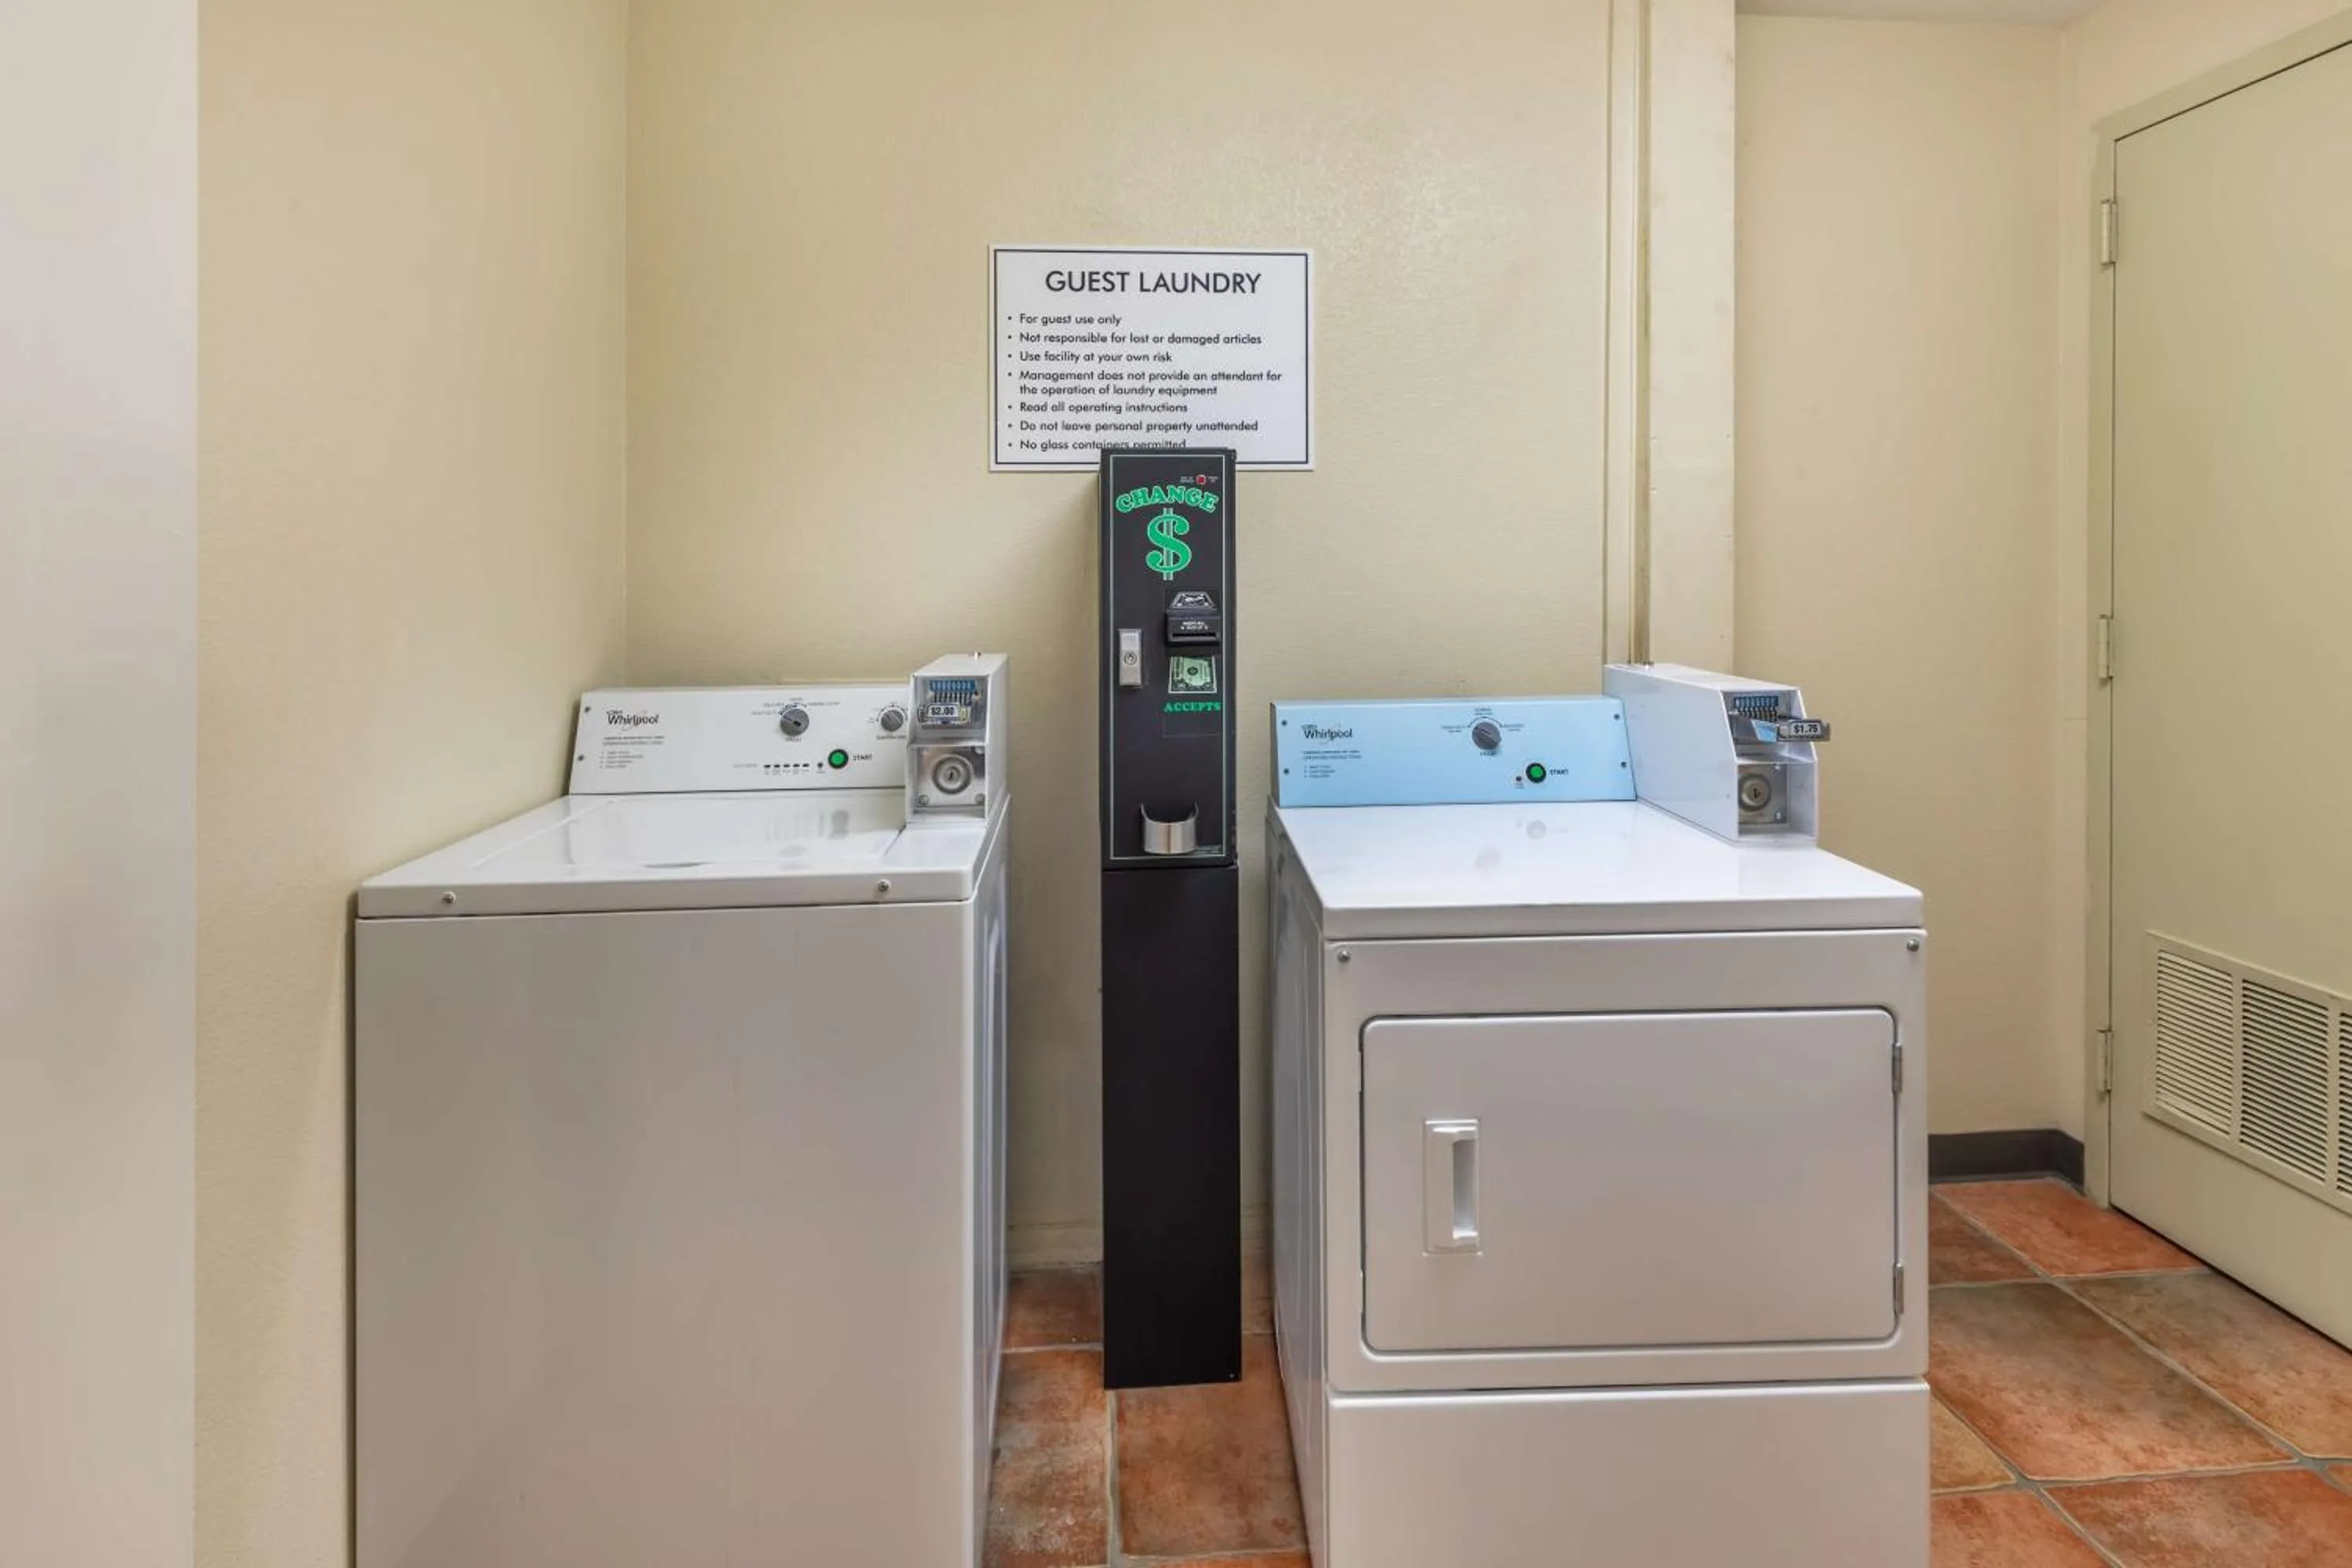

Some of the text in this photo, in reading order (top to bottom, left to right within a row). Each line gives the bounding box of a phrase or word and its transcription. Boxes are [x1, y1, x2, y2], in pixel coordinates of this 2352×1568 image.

[1046, 270, 1261, 293] GUEST LAUNDRY
[1020, 314, 1037, 323] For
[1041, 316, 1071, 326] guest
[1098, 314, 1121, 326] only
[1020, 332, 1040, 342] Not
[1044, 332, 1107, 344] responsible
[1111, 332, 1125, 343] for
[1131, 332, 1149, 343] lost
[1168, 333, 1220, 345] damaged
[1223, 334, 1261, 343] articles
[1020, 351, 1040, 361] Use
[1044, 351, 1080, 363] facility
[1098, 354, 1123, 364] your
[1153, 352, 1171, 362] risk
[1020, 370, 1094, 383] Management
[1098, 370, 1123, 379] does
[1149, 370, 1189, 383] provide
[1211, 371, 1263, 381] attendant
[1267, 370, 1281, 380] for
[1020, 384, 1217, 397] the operation of laundry equipment
[1021, 401, 1187, 414] Read all operating instructions
[1021, 420, 1258, 433] Do not leave personal property unattended
[1021, 439, 1186, 452] No glass containers permitted
[1116, 485, 1219, 514] CHANGE
[931, 707, 954, 716] $2.00
[1163, 702, 1221, 712] ACCEPTS
[606, 714, 659, 727] Whirlpool
[1304, 728, 1352, 740] Whirlpool
[1794, 724, 1818, 733] $1.75
